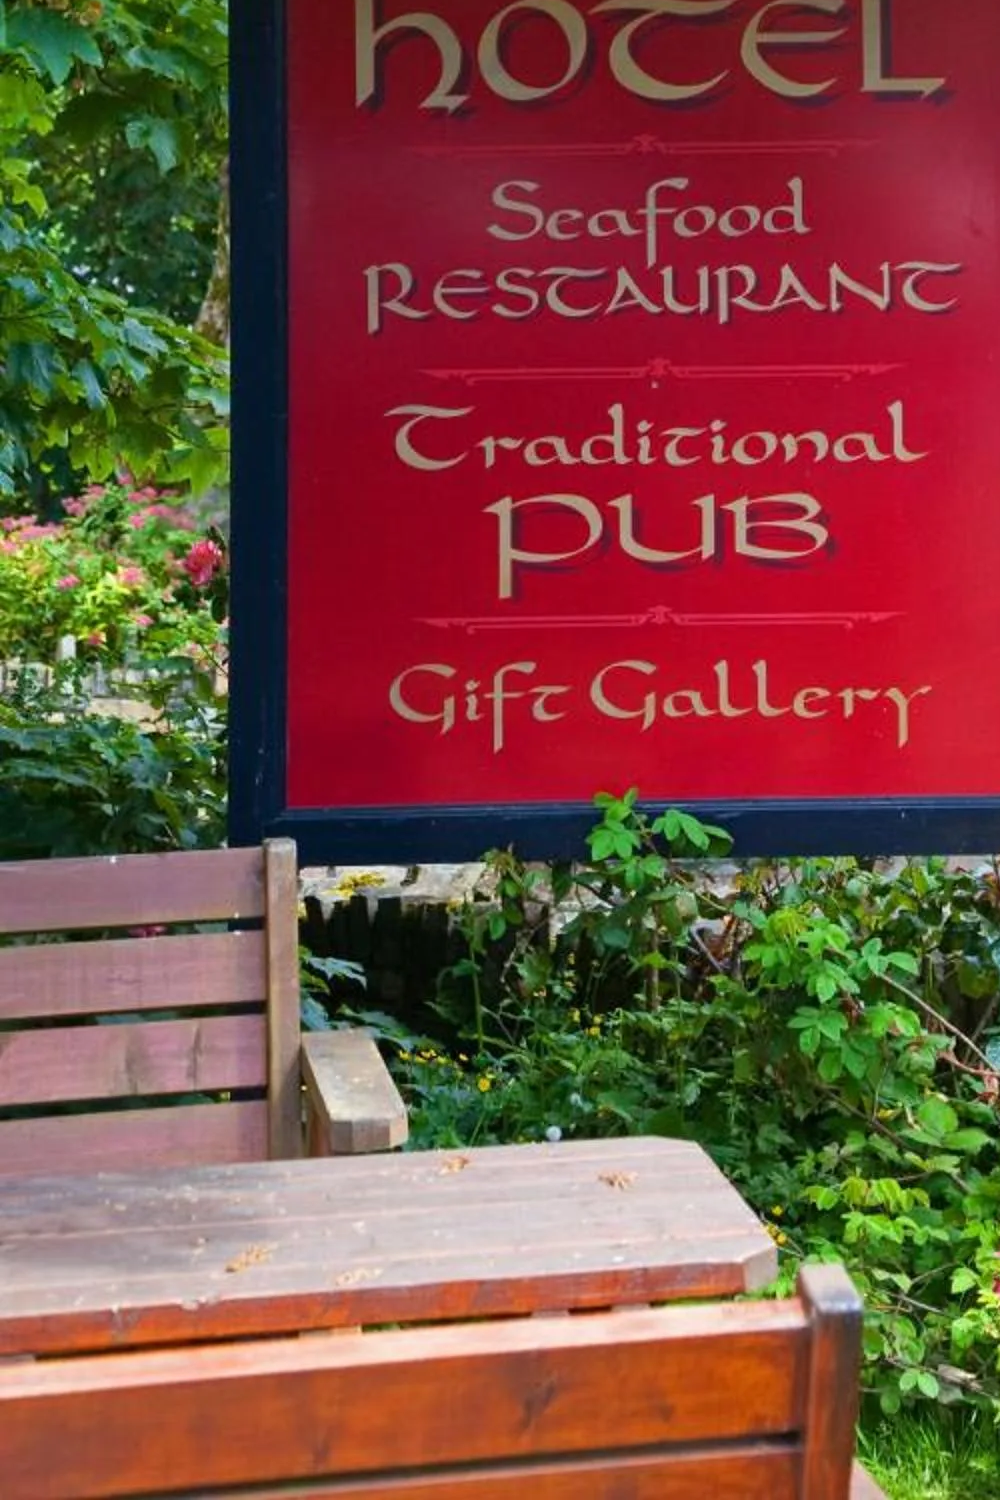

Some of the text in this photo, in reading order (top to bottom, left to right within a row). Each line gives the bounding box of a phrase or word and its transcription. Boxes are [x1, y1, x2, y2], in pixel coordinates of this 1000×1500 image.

[487, 177, 809, 267] Seafood
[363, 261, 963, 335] RESTAURANT
[385, 401, 930, 471] Traditional
[482, 493, 830, 600] PUB
[389, 659, 932, 753] Gift Gallery
